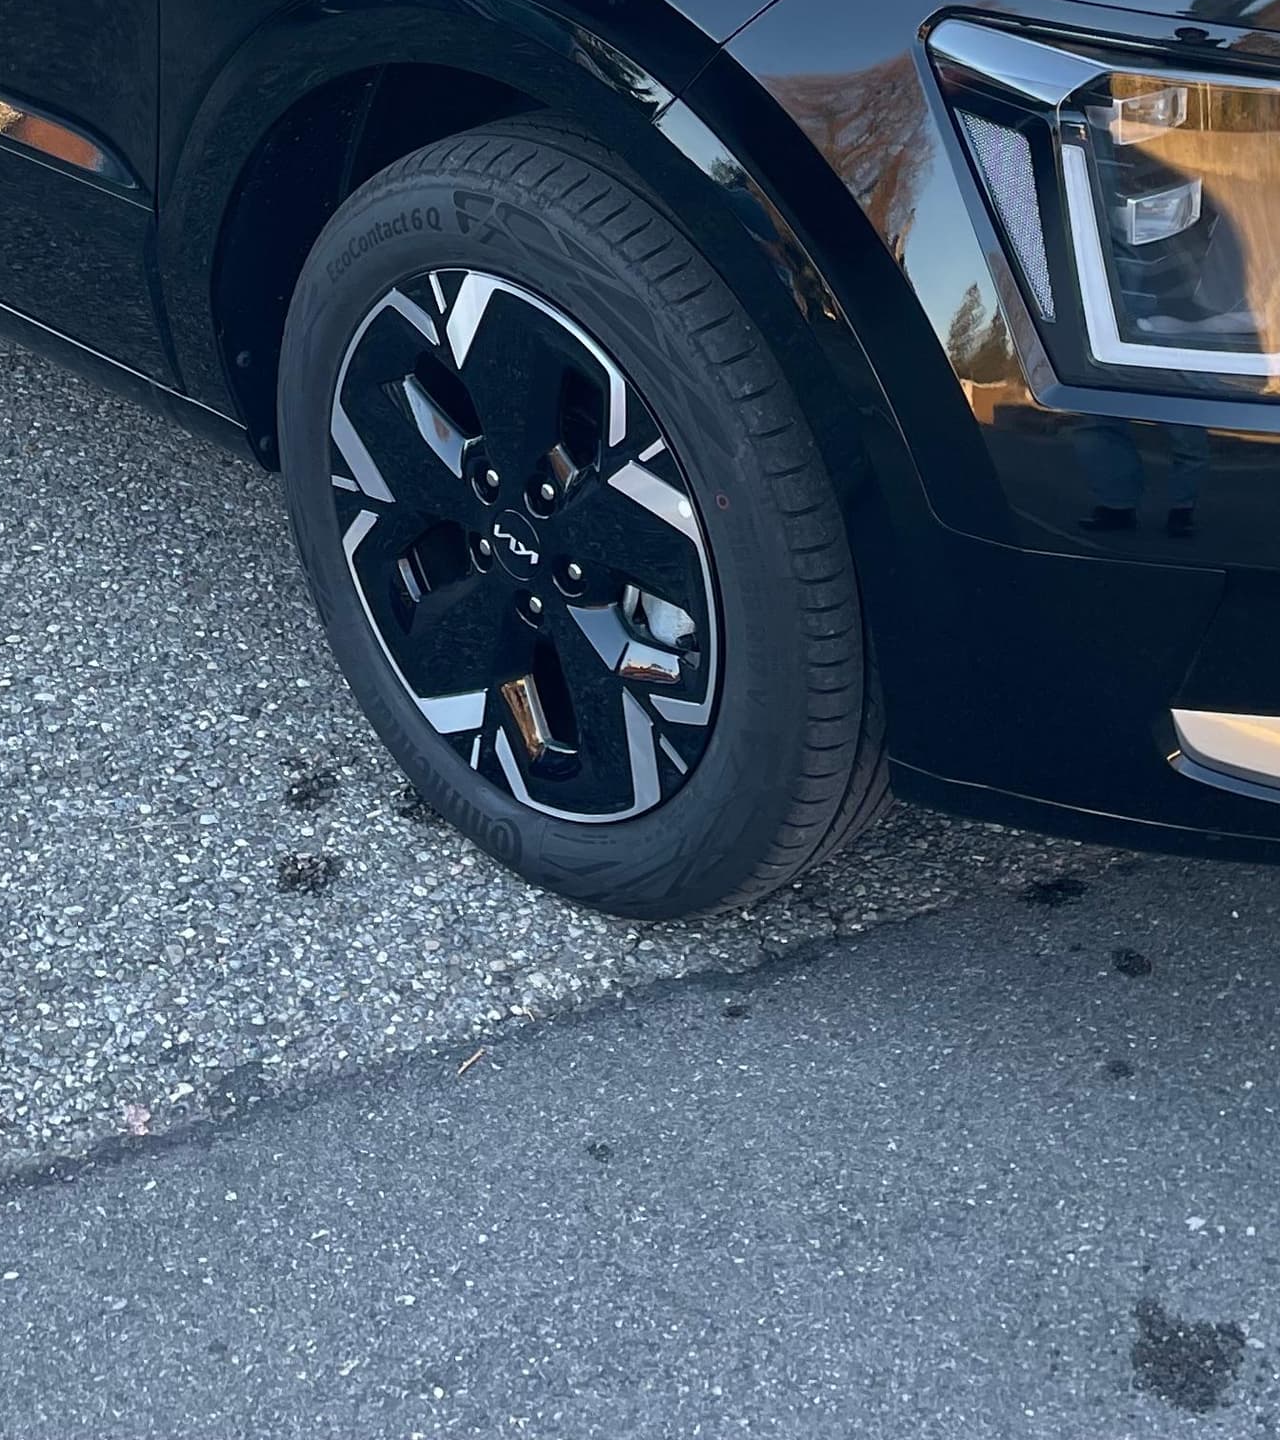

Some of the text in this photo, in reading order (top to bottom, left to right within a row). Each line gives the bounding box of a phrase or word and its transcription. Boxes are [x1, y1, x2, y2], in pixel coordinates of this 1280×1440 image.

[326, 207, 443, 282] EcoContact 6 Q
